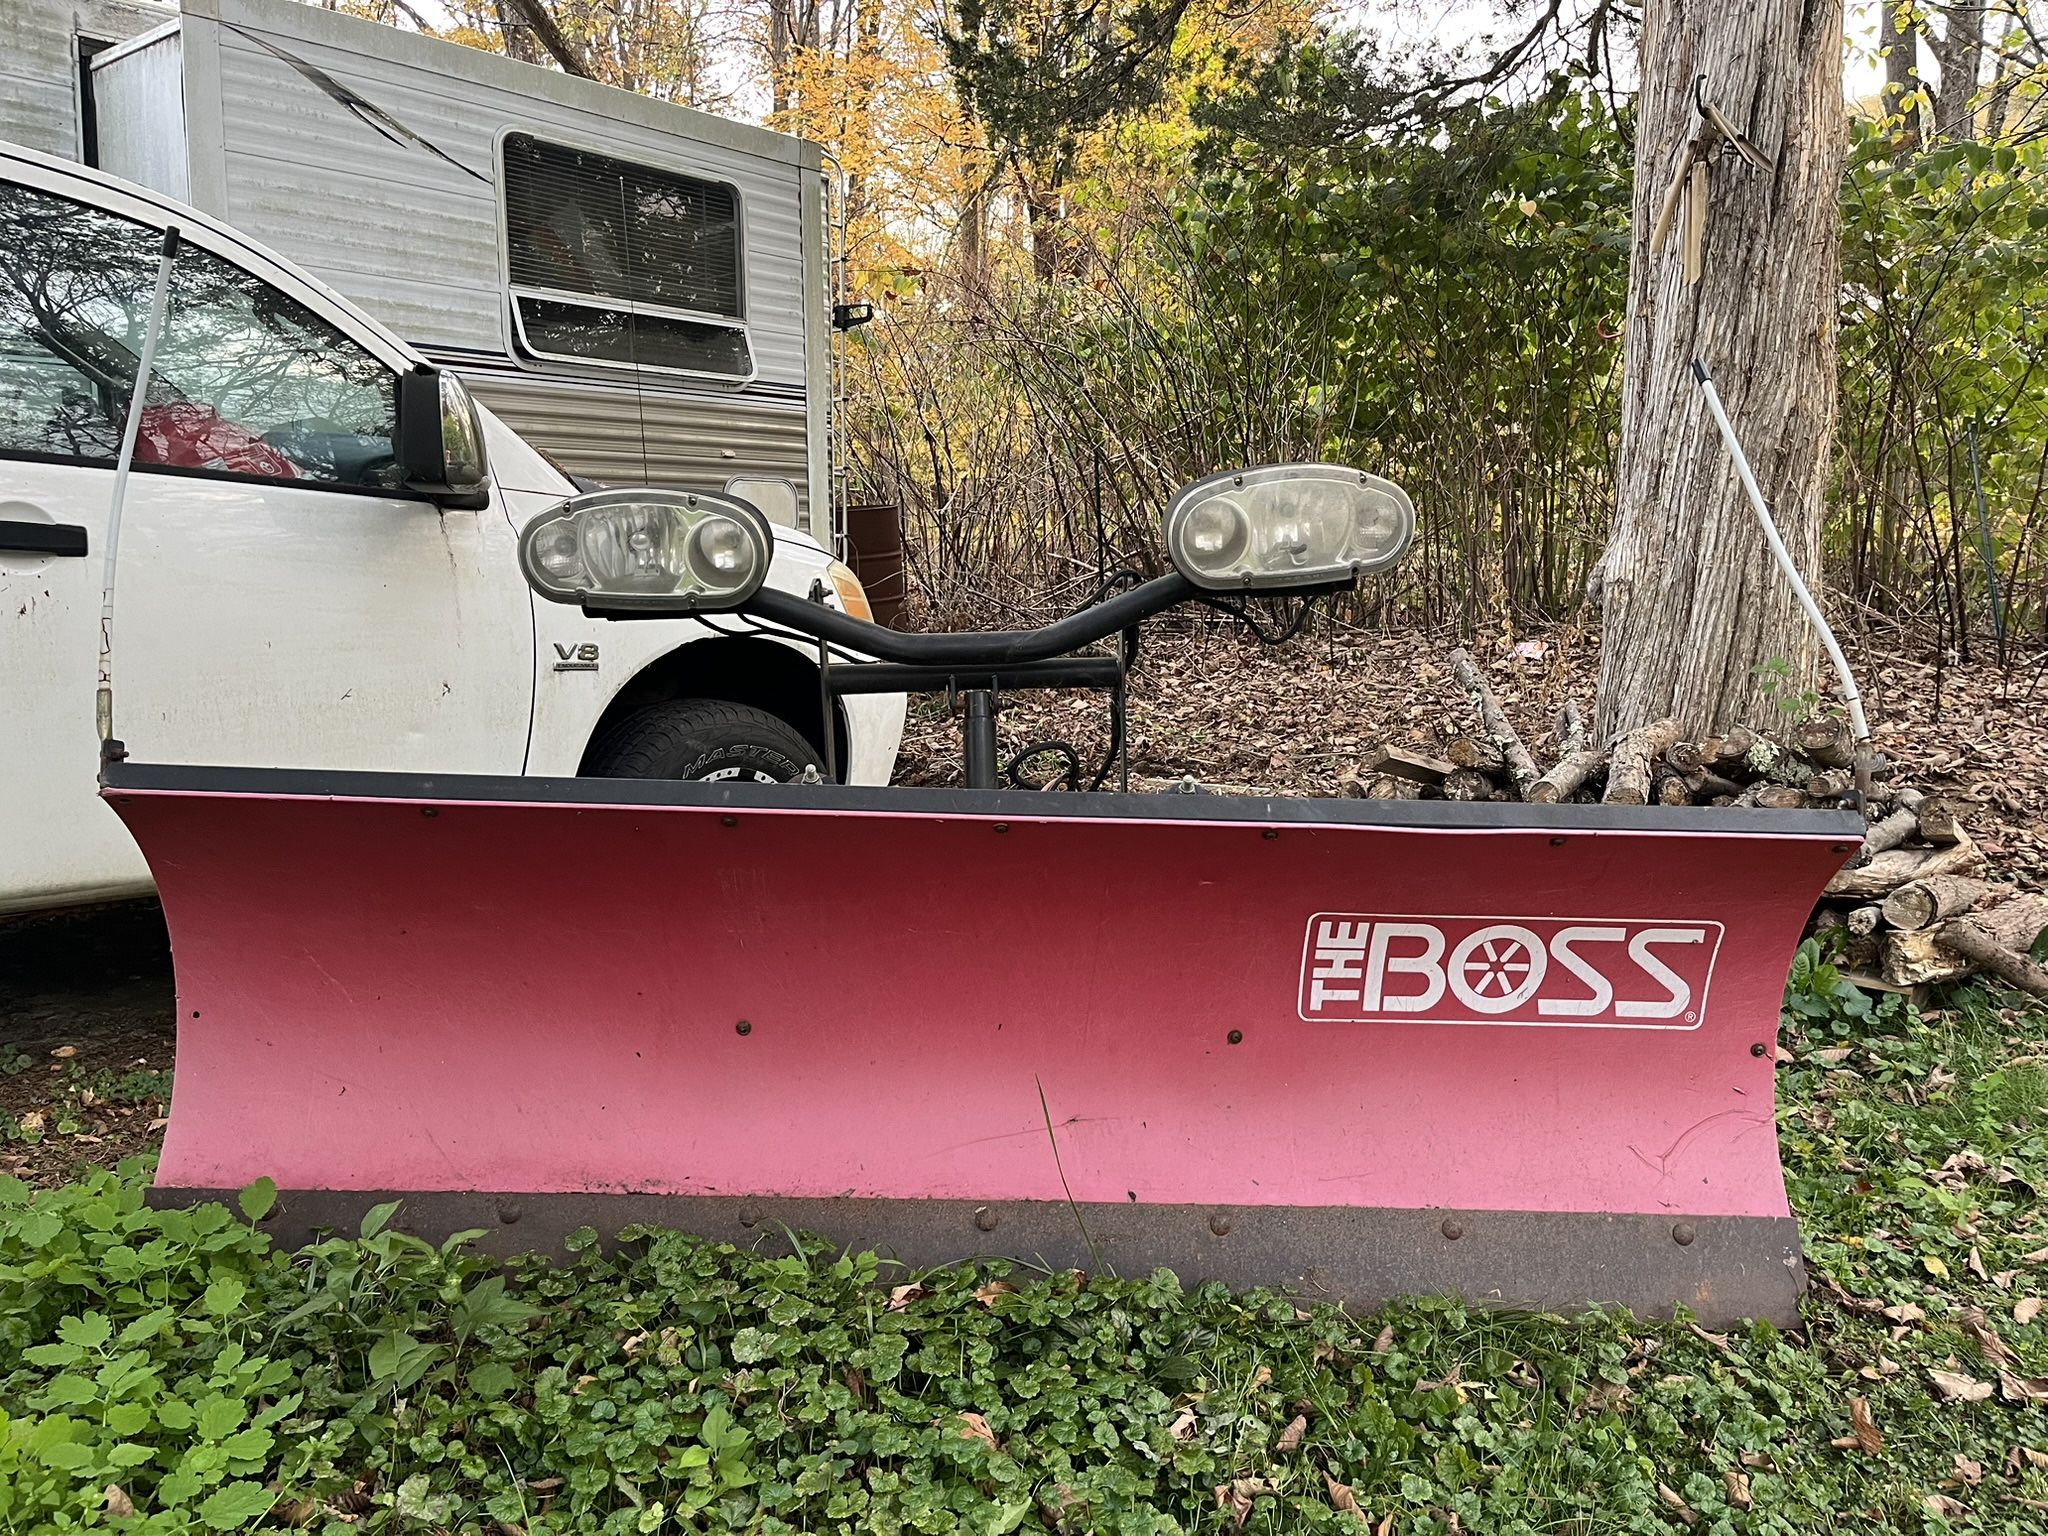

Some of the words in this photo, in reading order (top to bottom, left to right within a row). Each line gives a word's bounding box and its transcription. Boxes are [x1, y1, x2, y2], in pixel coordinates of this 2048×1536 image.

[553, 643, 599, 660] V8
[682, 744, 800, 779] MASTER
[1309, 921, 1370, 1011] THE
[1362, 922, 1705, 1018] BOSS
